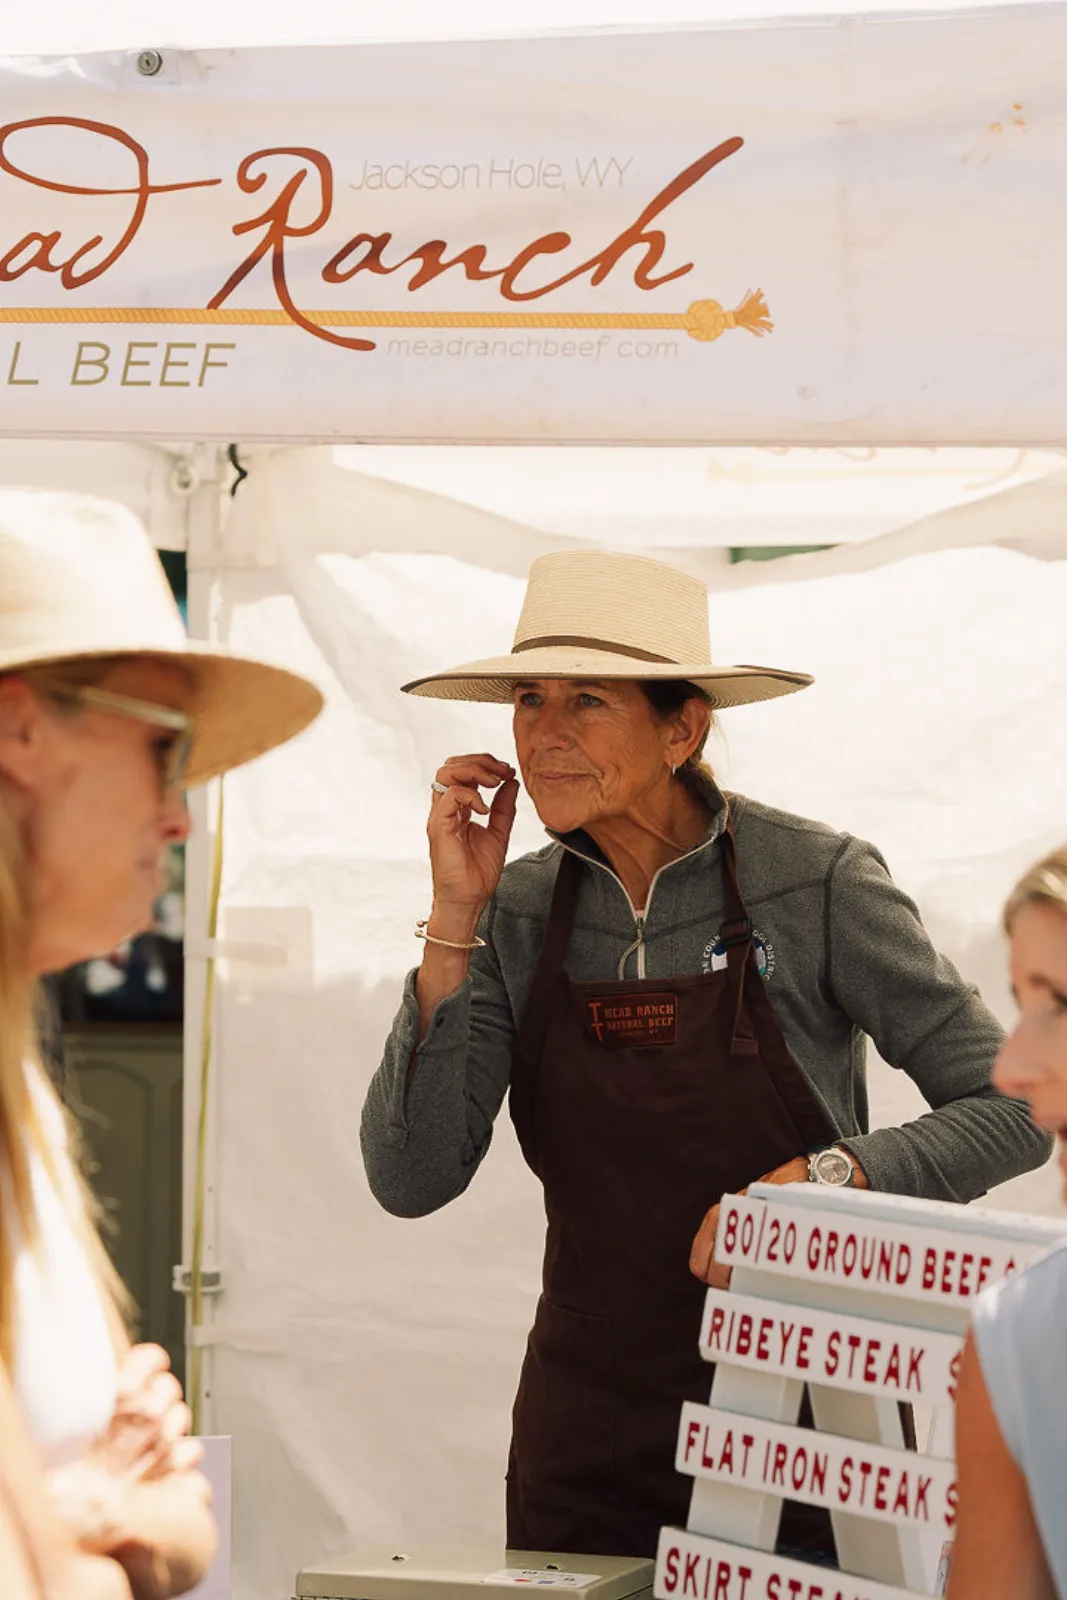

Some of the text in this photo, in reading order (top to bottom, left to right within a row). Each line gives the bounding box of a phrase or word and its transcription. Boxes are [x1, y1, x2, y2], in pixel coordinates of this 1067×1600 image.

[349, 156, 635, 191] Jackson Hole, WY
[206, 136, 744, 352] Ranch
[71, 341, 237, 388] BEEF
[724, 1205, 993, 1296] 80/20 GROUND BEEF
[707, 1308, 814, 1369] RIBEYE
[824, 1331, 925, 1393] STEAK
[684, 1422, 754, 1478] FLAT
[762, 1440, 829, 1495] IRON
[838, 1457, 932, 1523] STEAK
[664, 1547, 753, 1600] SKIRT
